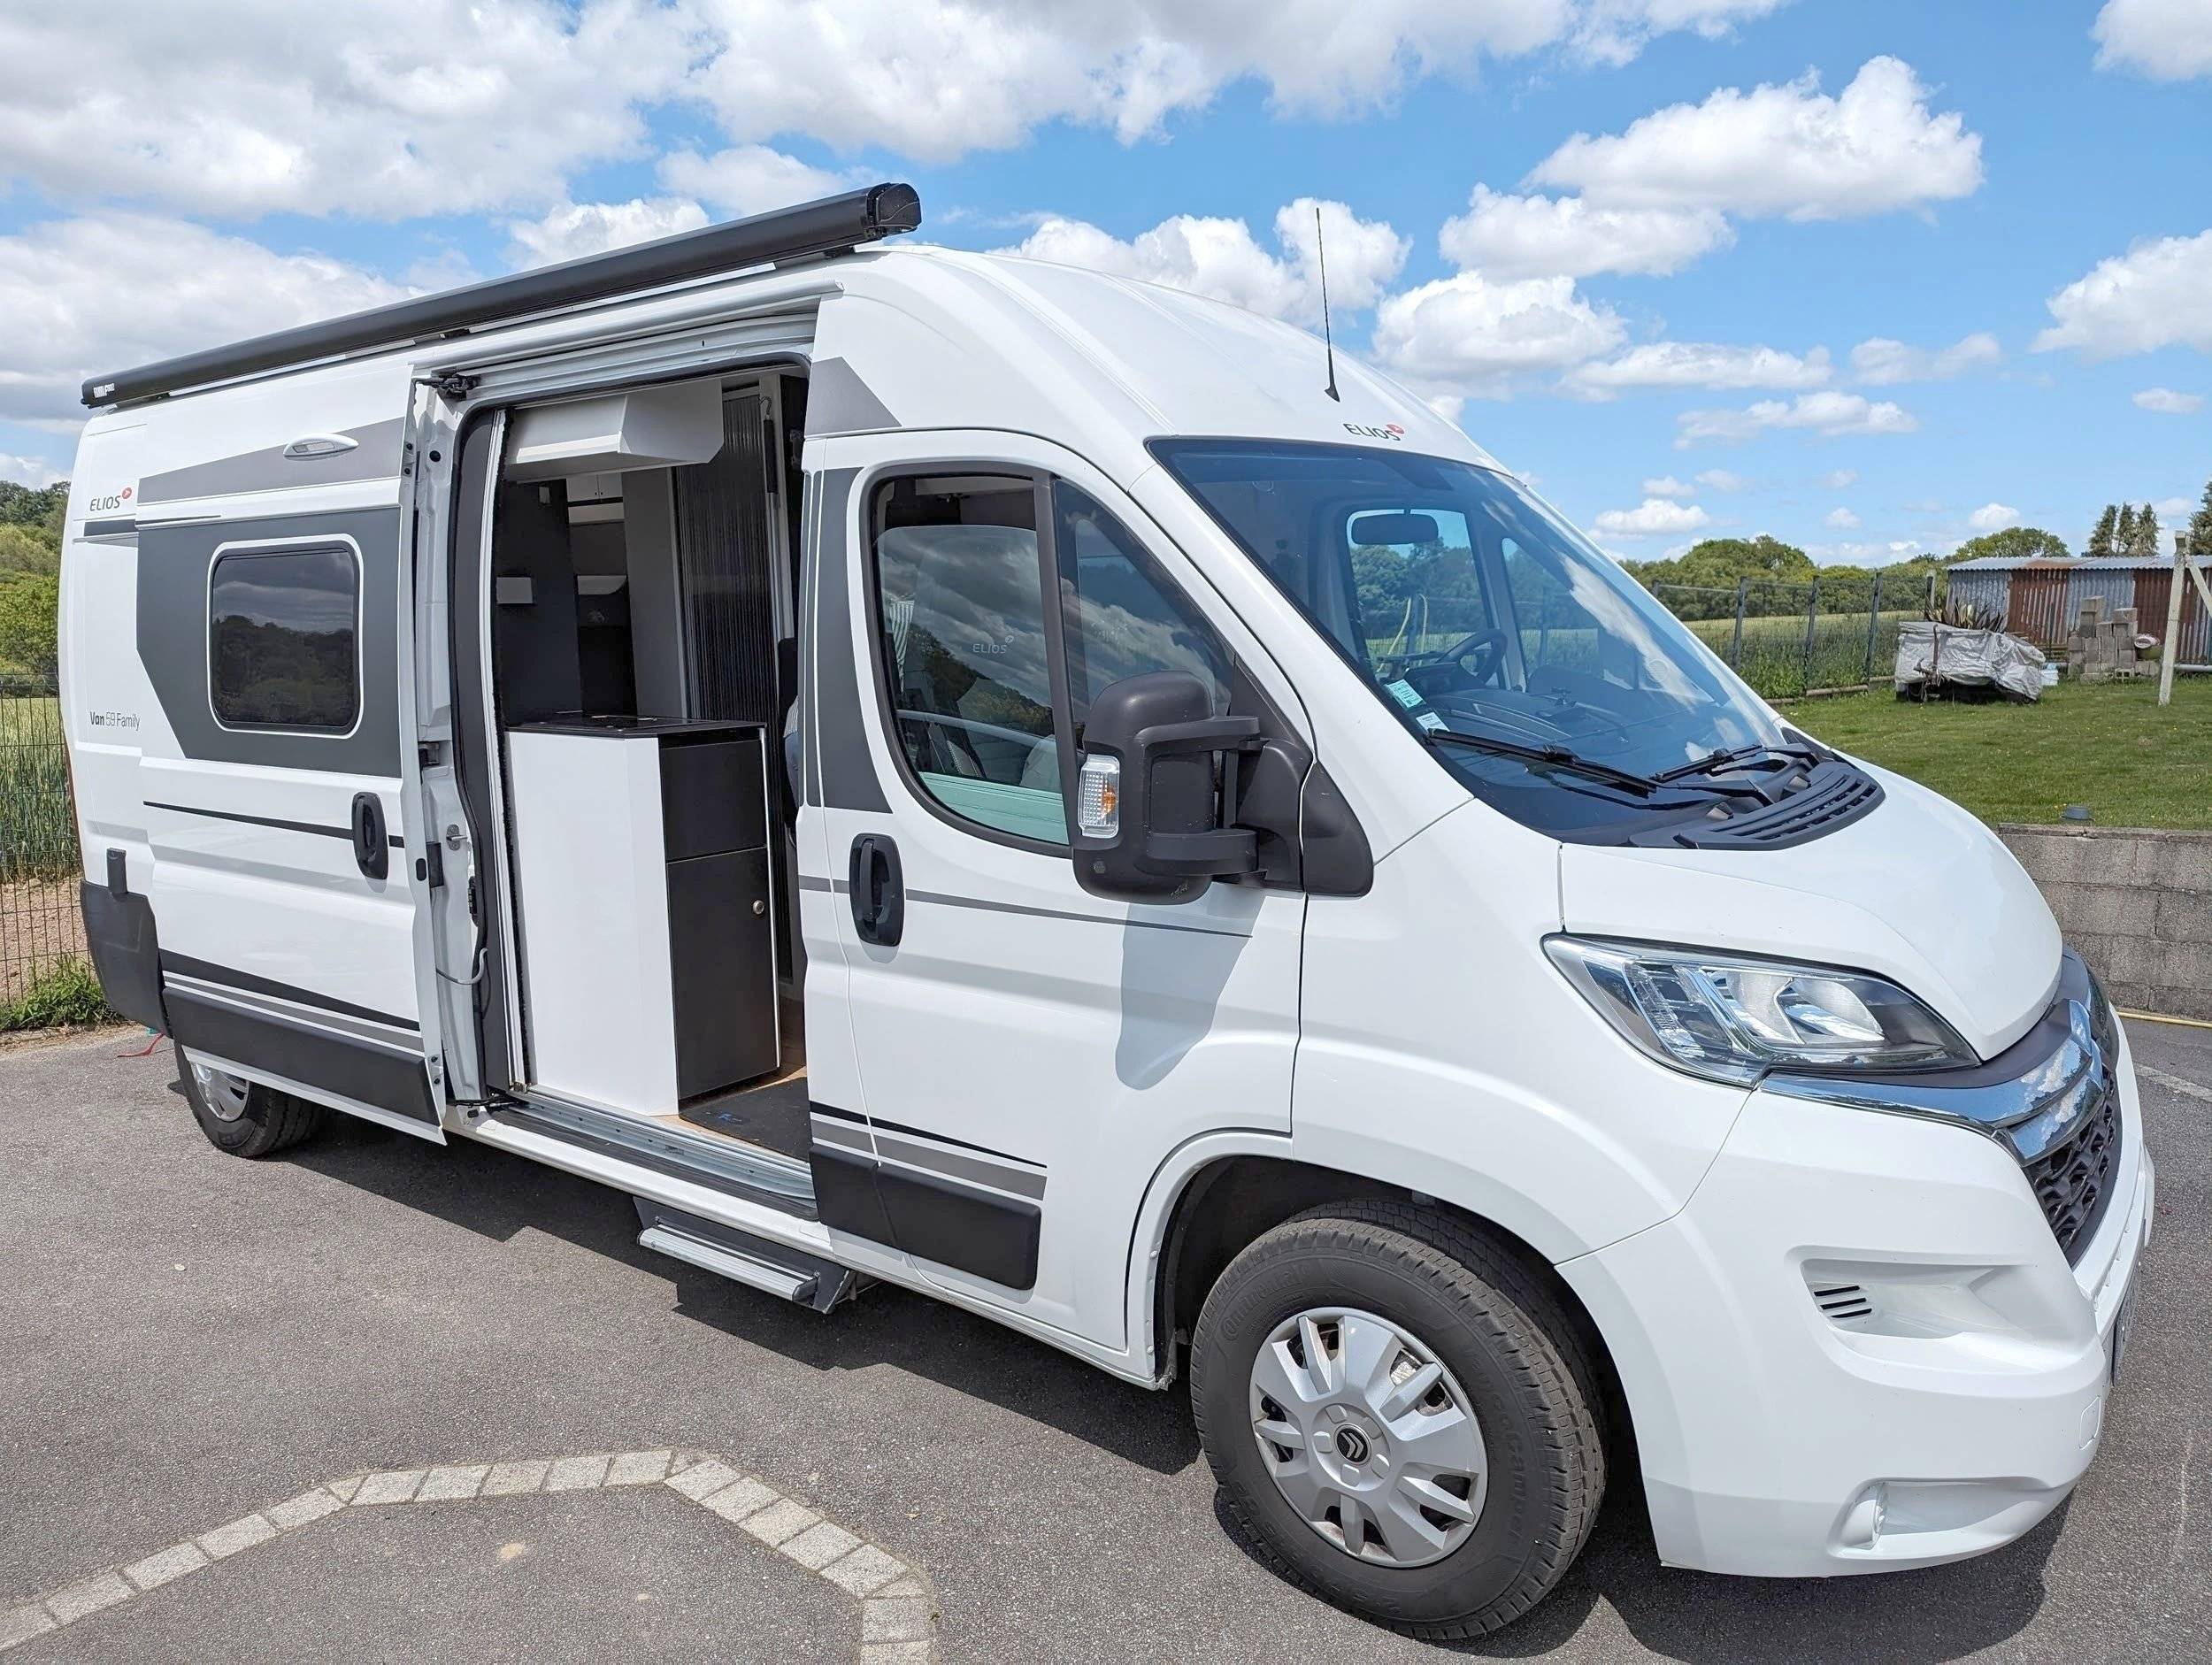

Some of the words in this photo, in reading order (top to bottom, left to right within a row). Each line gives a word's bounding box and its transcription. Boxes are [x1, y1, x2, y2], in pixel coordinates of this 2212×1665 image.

[1342, 423, 1401, 441] ELIOS
[89, 495, 122, 511] ELIOS
[972, 643, 1008, 654] ELIOS
[89, 711, 105, 725] Van
[116, 712, 140, 731] Family
